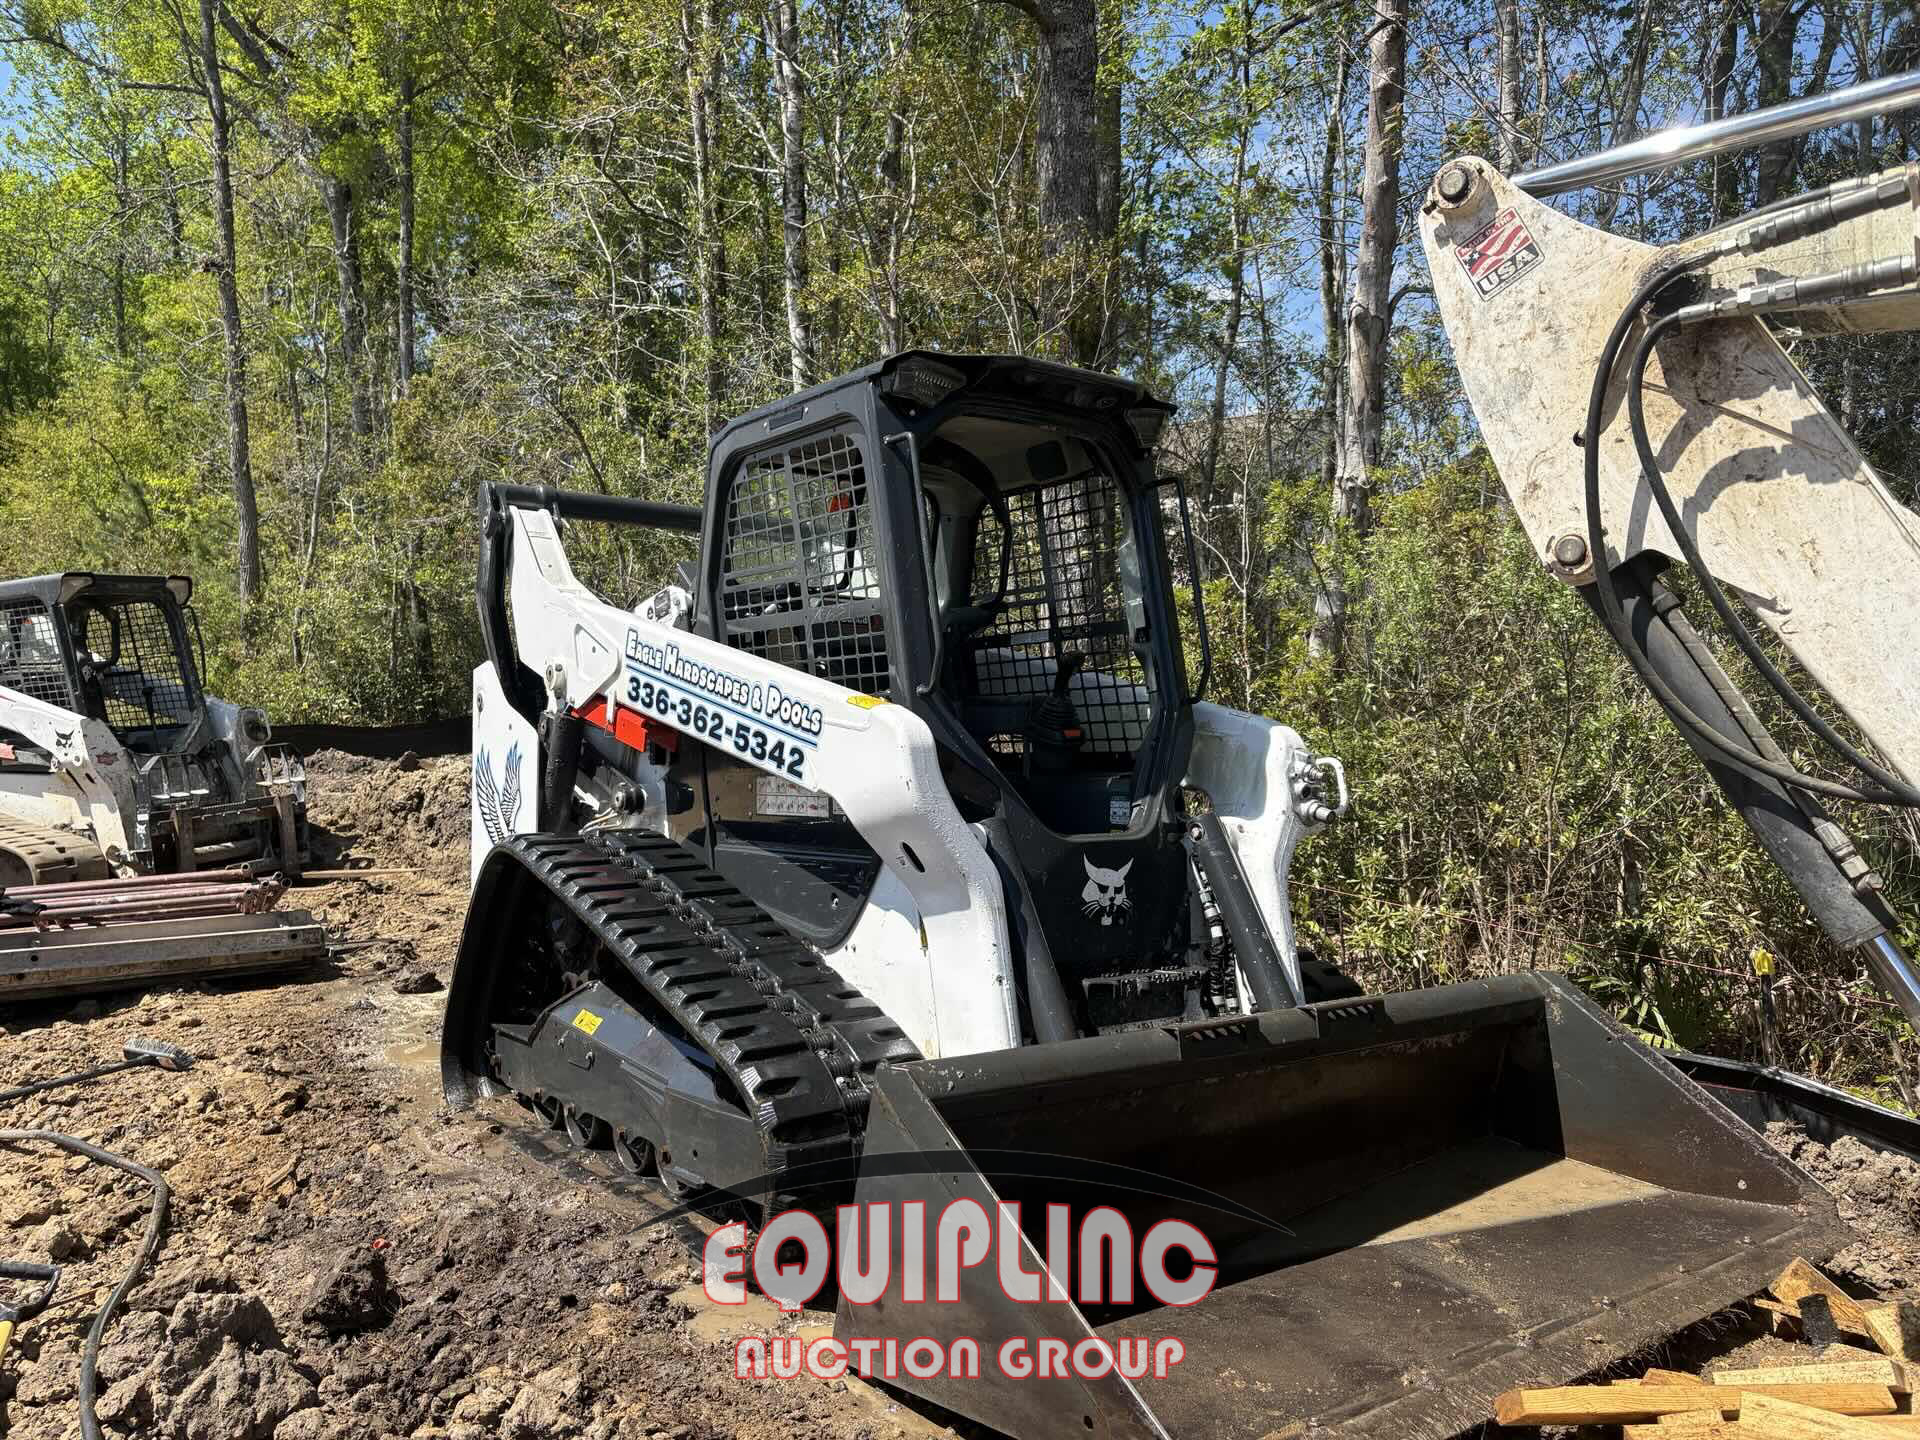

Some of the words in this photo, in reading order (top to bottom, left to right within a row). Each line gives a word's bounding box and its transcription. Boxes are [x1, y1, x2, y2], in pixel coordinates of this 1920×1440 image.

[1480, 249, 1538, 292] USA
[626, 629, 663, 669] EAGLE
[664, 643, 751, 707] HARDSCAPES
[751, 685, 763, 712] &
[766, 684, 823, 735] POOLS
[627, 676, 806, 779] 336-362-5342
